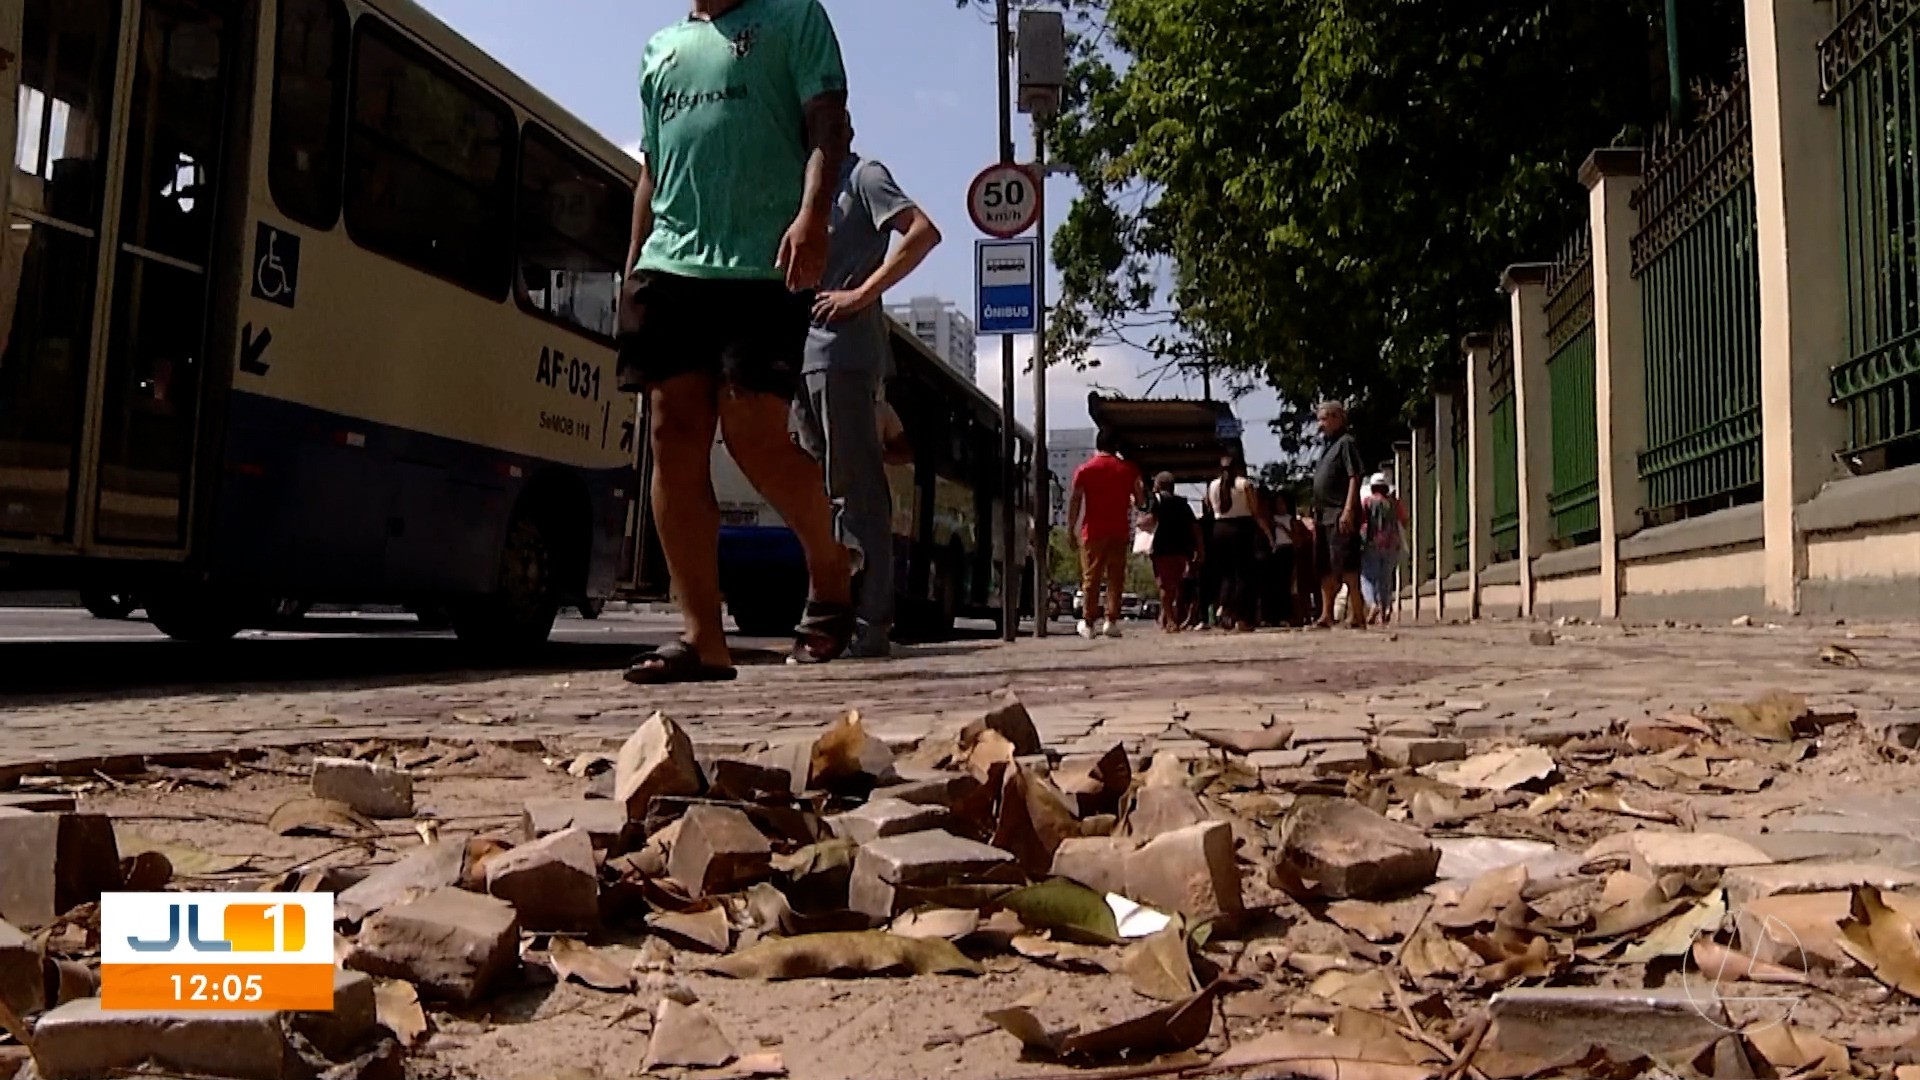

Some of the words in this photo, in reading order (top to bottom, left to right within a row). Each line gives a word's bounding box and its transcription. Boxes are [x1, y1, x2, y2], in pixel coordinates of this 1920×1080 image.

[983, 181, 1024, 207] 50
[986, 210, 1022, 223] km/h
[983, 303, 1030, 319] ÔNIBUS
